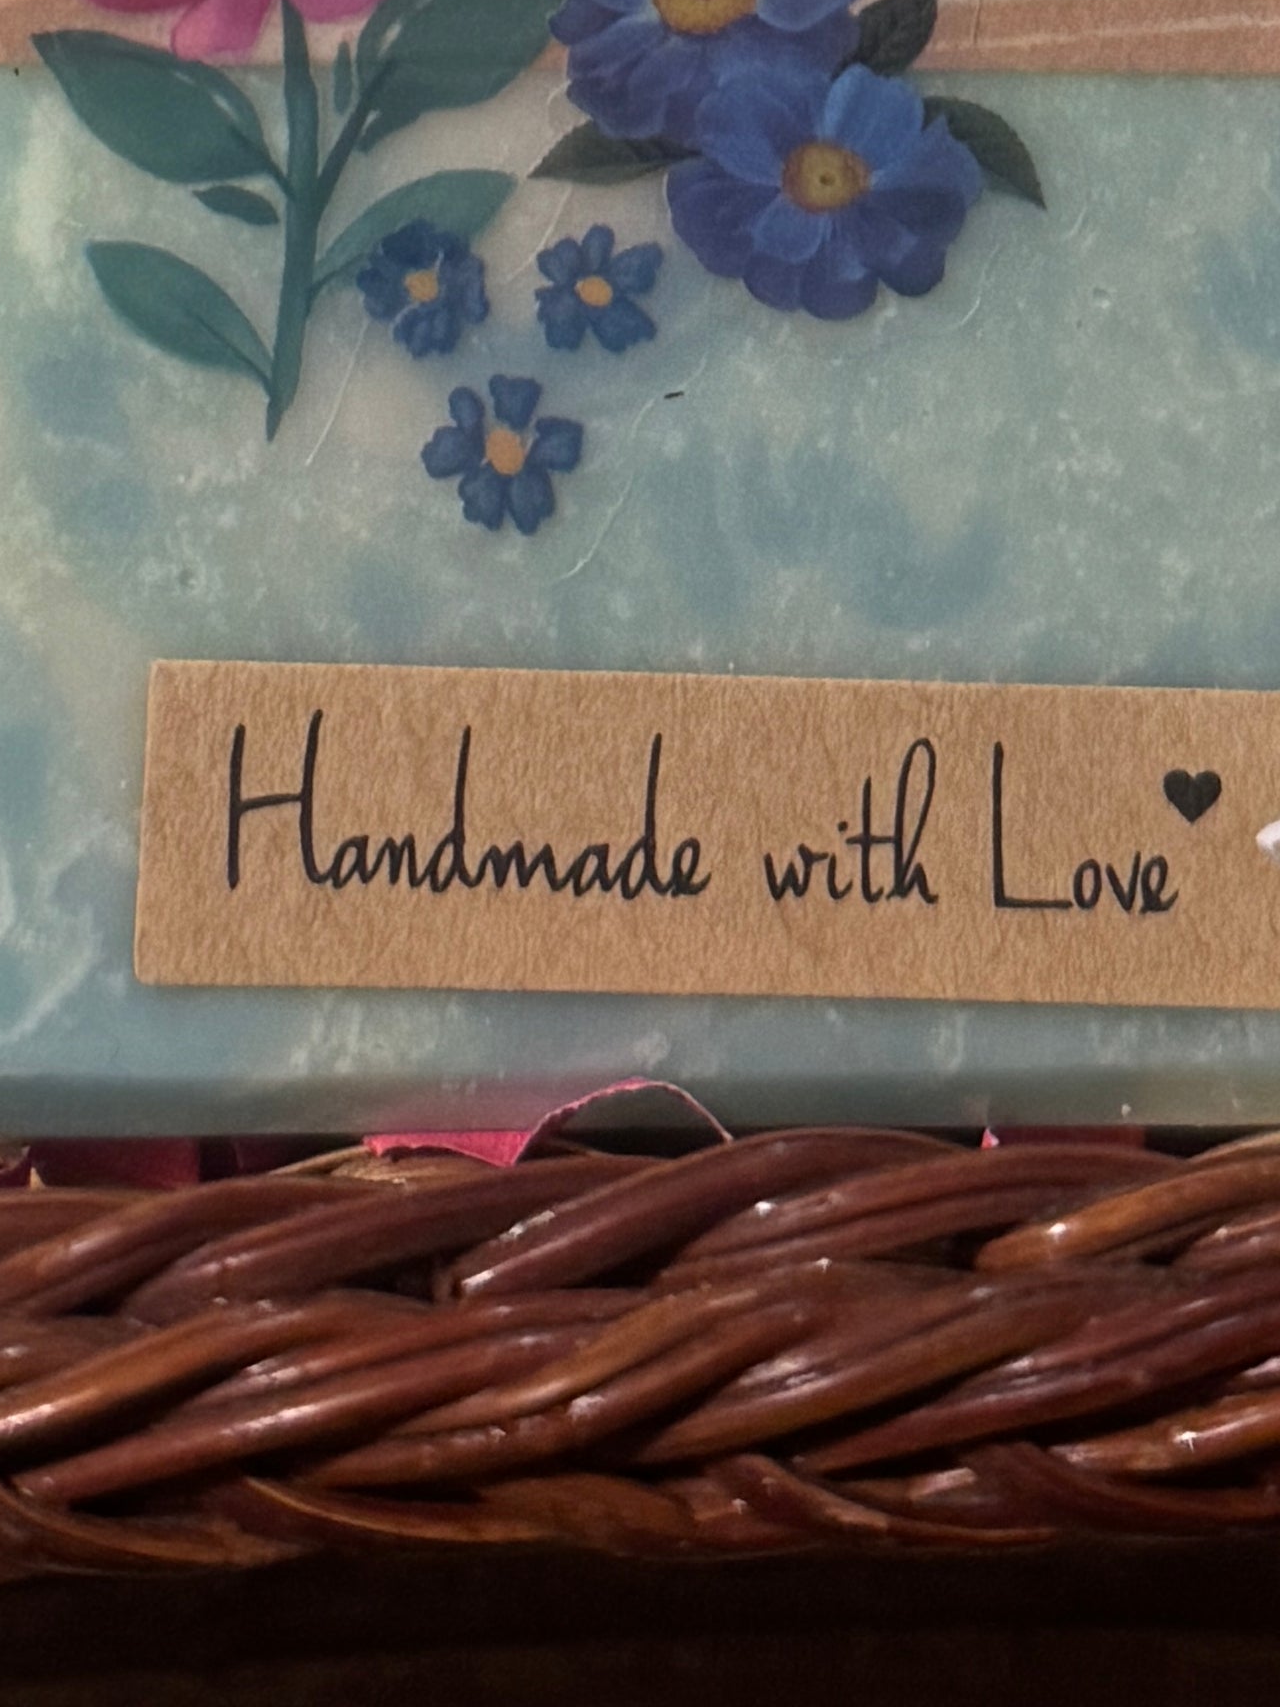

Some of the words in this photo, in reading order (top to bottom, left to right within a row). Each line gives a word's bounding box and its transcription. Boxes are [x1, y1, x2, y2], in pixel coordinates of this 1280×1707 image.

[227, 708, 712, 899] Handmade
[763, 737, 939, 905] with
[991, 740, 1179, 916] Love
